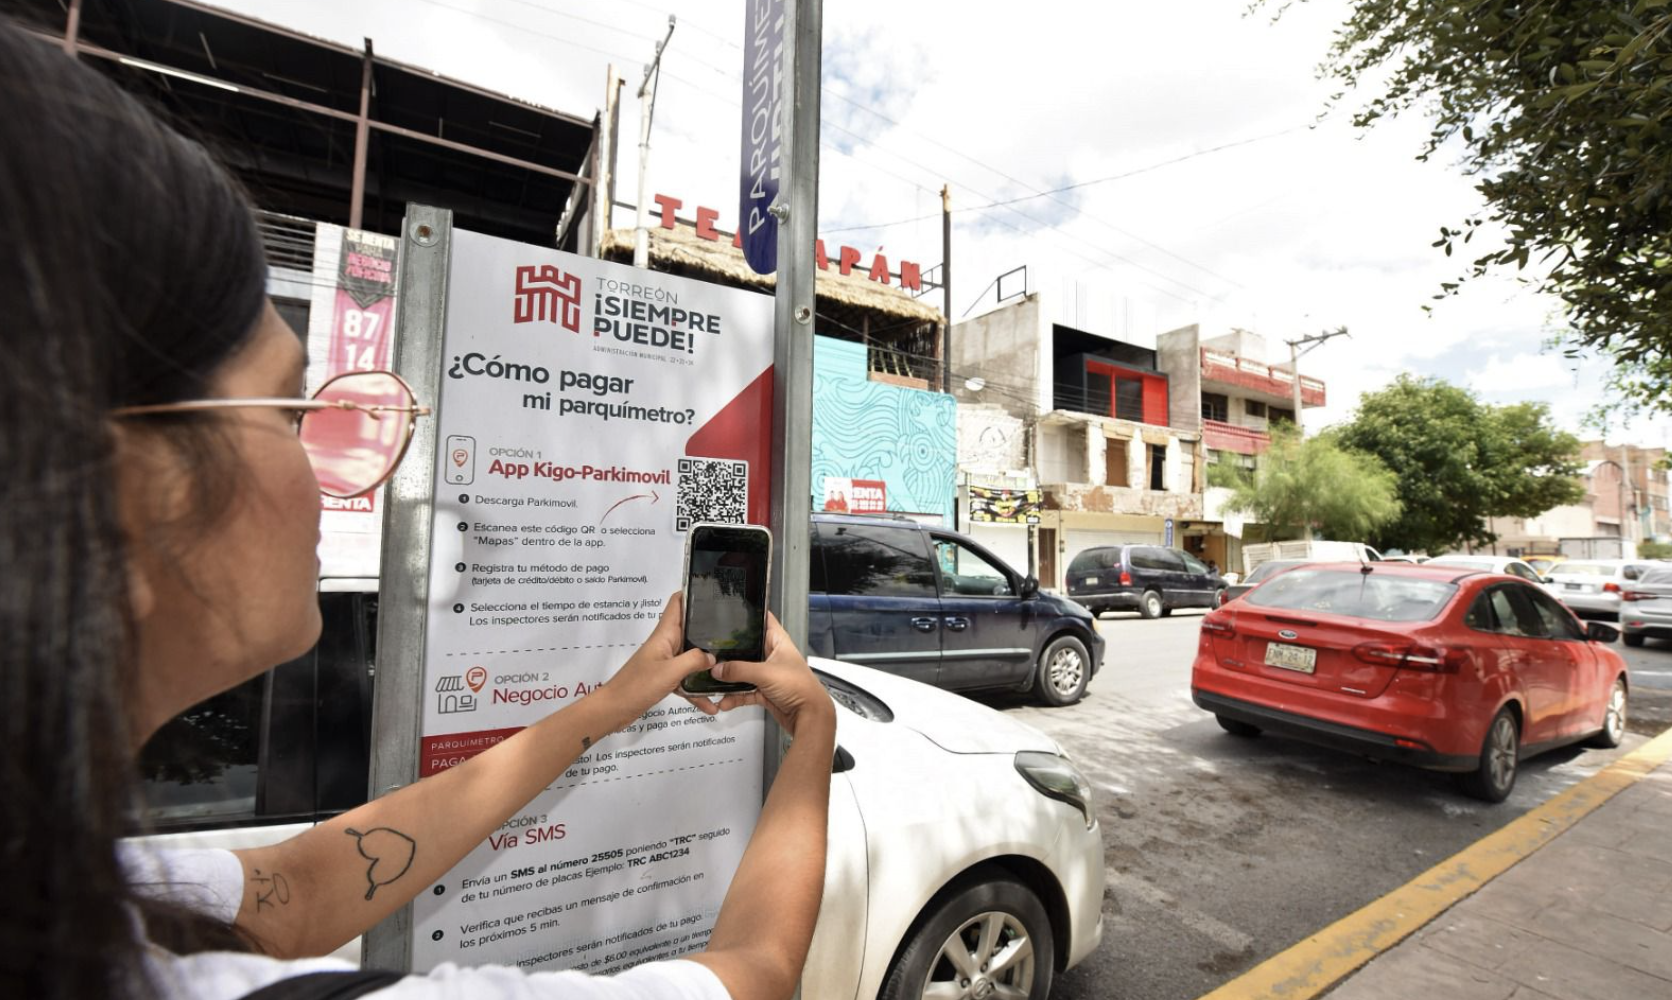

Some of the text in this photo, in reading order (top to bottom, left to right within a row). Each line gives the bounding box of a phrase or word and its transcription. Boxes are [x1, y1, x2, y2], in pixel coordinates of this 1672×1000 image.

[749, 0, 771, 235] PARQUÍME
[595, 276, 678, 305] TORREÓN
[343, 308, 380, 340] 87
[594, 294, 721, 335] ¡SIEMPRE
[593, 317, 694, 354] PUEDE!
[345, 343, 375, 371] 14
[448, 352, 635, 396] ¿Cómo pagar
[523, 392, 695, 425] mi parquímetro?
[489, 446, 542, 459] OPCIÓN 1
[488, 459, 671, 485] App Kigo-Parkimovil
[475, 495, 524, 507] Descarga
[527, 497, 578, 508] Parkimovil.
[473, 522, 518, 532] Escanea
[521, 525, 542, 533] este
[545, 525, 578, 536] código
[580, 526, 596, 535] QR
[609, 526, 656, 535] selecciona
[521, 536, 555, 546] dentro
[558, 537, 571, 546] de
[574, 537, 583, 546] la
[585, 540, 606, 550] app.
[472, 563, 514, 574] Registra
[517, 564, 527, 573] tu
[530, 563, 568, 573] método
[571, 564, 583, 573] de
[586, 564, 609, 574] pago
[472, 577, 501, 587] (tarjeta
[504, 577, 516, 585] de
[518, 576, 574, 584] crédito/débito
[585, 576, 605, 584] saldo
[470, 602, 527, 612] Selecciona
[530, 601, 539, 610] el
[542, 601, 575, 612] tiempo
[578, 600, 591, 609] de
[593, 599, 630, 609] estancia
[632, 601, 638, 609] y
[469, 616, 488, 626] Los
[491, 615, 550, 627] inspectores
[553, 613, 579, 622] serán
[582, 612, 631, 621] notificados
[633, 611, 644, 619] de
[647, 611, 656, 619] tu
[494, 672, 549, 685] OPCIÓN 2
[493, 685, 568, 706] Negocio
[638, 723, 645, 732] y
[646, 721, 668, 732] paga
[671, 719, 681, 727] en
[683, 715, 717, 726] efectivo.
[596, 752, 613, 762] Los
[615, 747, 665, 760] inspectores
[667, 741, 691, 752] serán
[693, 735, 736, 748] notificados
[565, 764, 619, 778] de tu pago.
[497, 814, 548, 831] PCIÓN 3
[489, 823, 566, 851] Vía SMS
[462, 876, 491, 890] Envía
[494, 873, 508, 883] un
[510, 867, 535, 879] SMS
[537, 864, 548, 874] al
[550, 857, 589, 872] número
[591, 848, 624, 863] 25505
[625, 840, 667, 858] poniendo
[698, 827, 730, 841] seguido
[461, 847, 690, 904] de tu número de placas Ejemplo: TRC ABC1234
[460, 918, 501, 935] Verifica
[504, 913, 525, 926] que
[526, 902, 563, 920] recibas
[565, 900, 578, 911] un
[580, 891, 621, 908] mensaje
[622, 888, 635, 898] de
[636, 874, 691, 895] confirmación
[693, 871, 705, 881] en
[459, 918, 560, 949] los próximos 5 min.
[576, 939, 603, 956] serán
[605, 926, 654, 946] notificados
[655, 921, 668, 932] de
[669, 919, 678, 928] tu
[680, 913, 703, 927] pago.
[591, 958, 602, 968] de
